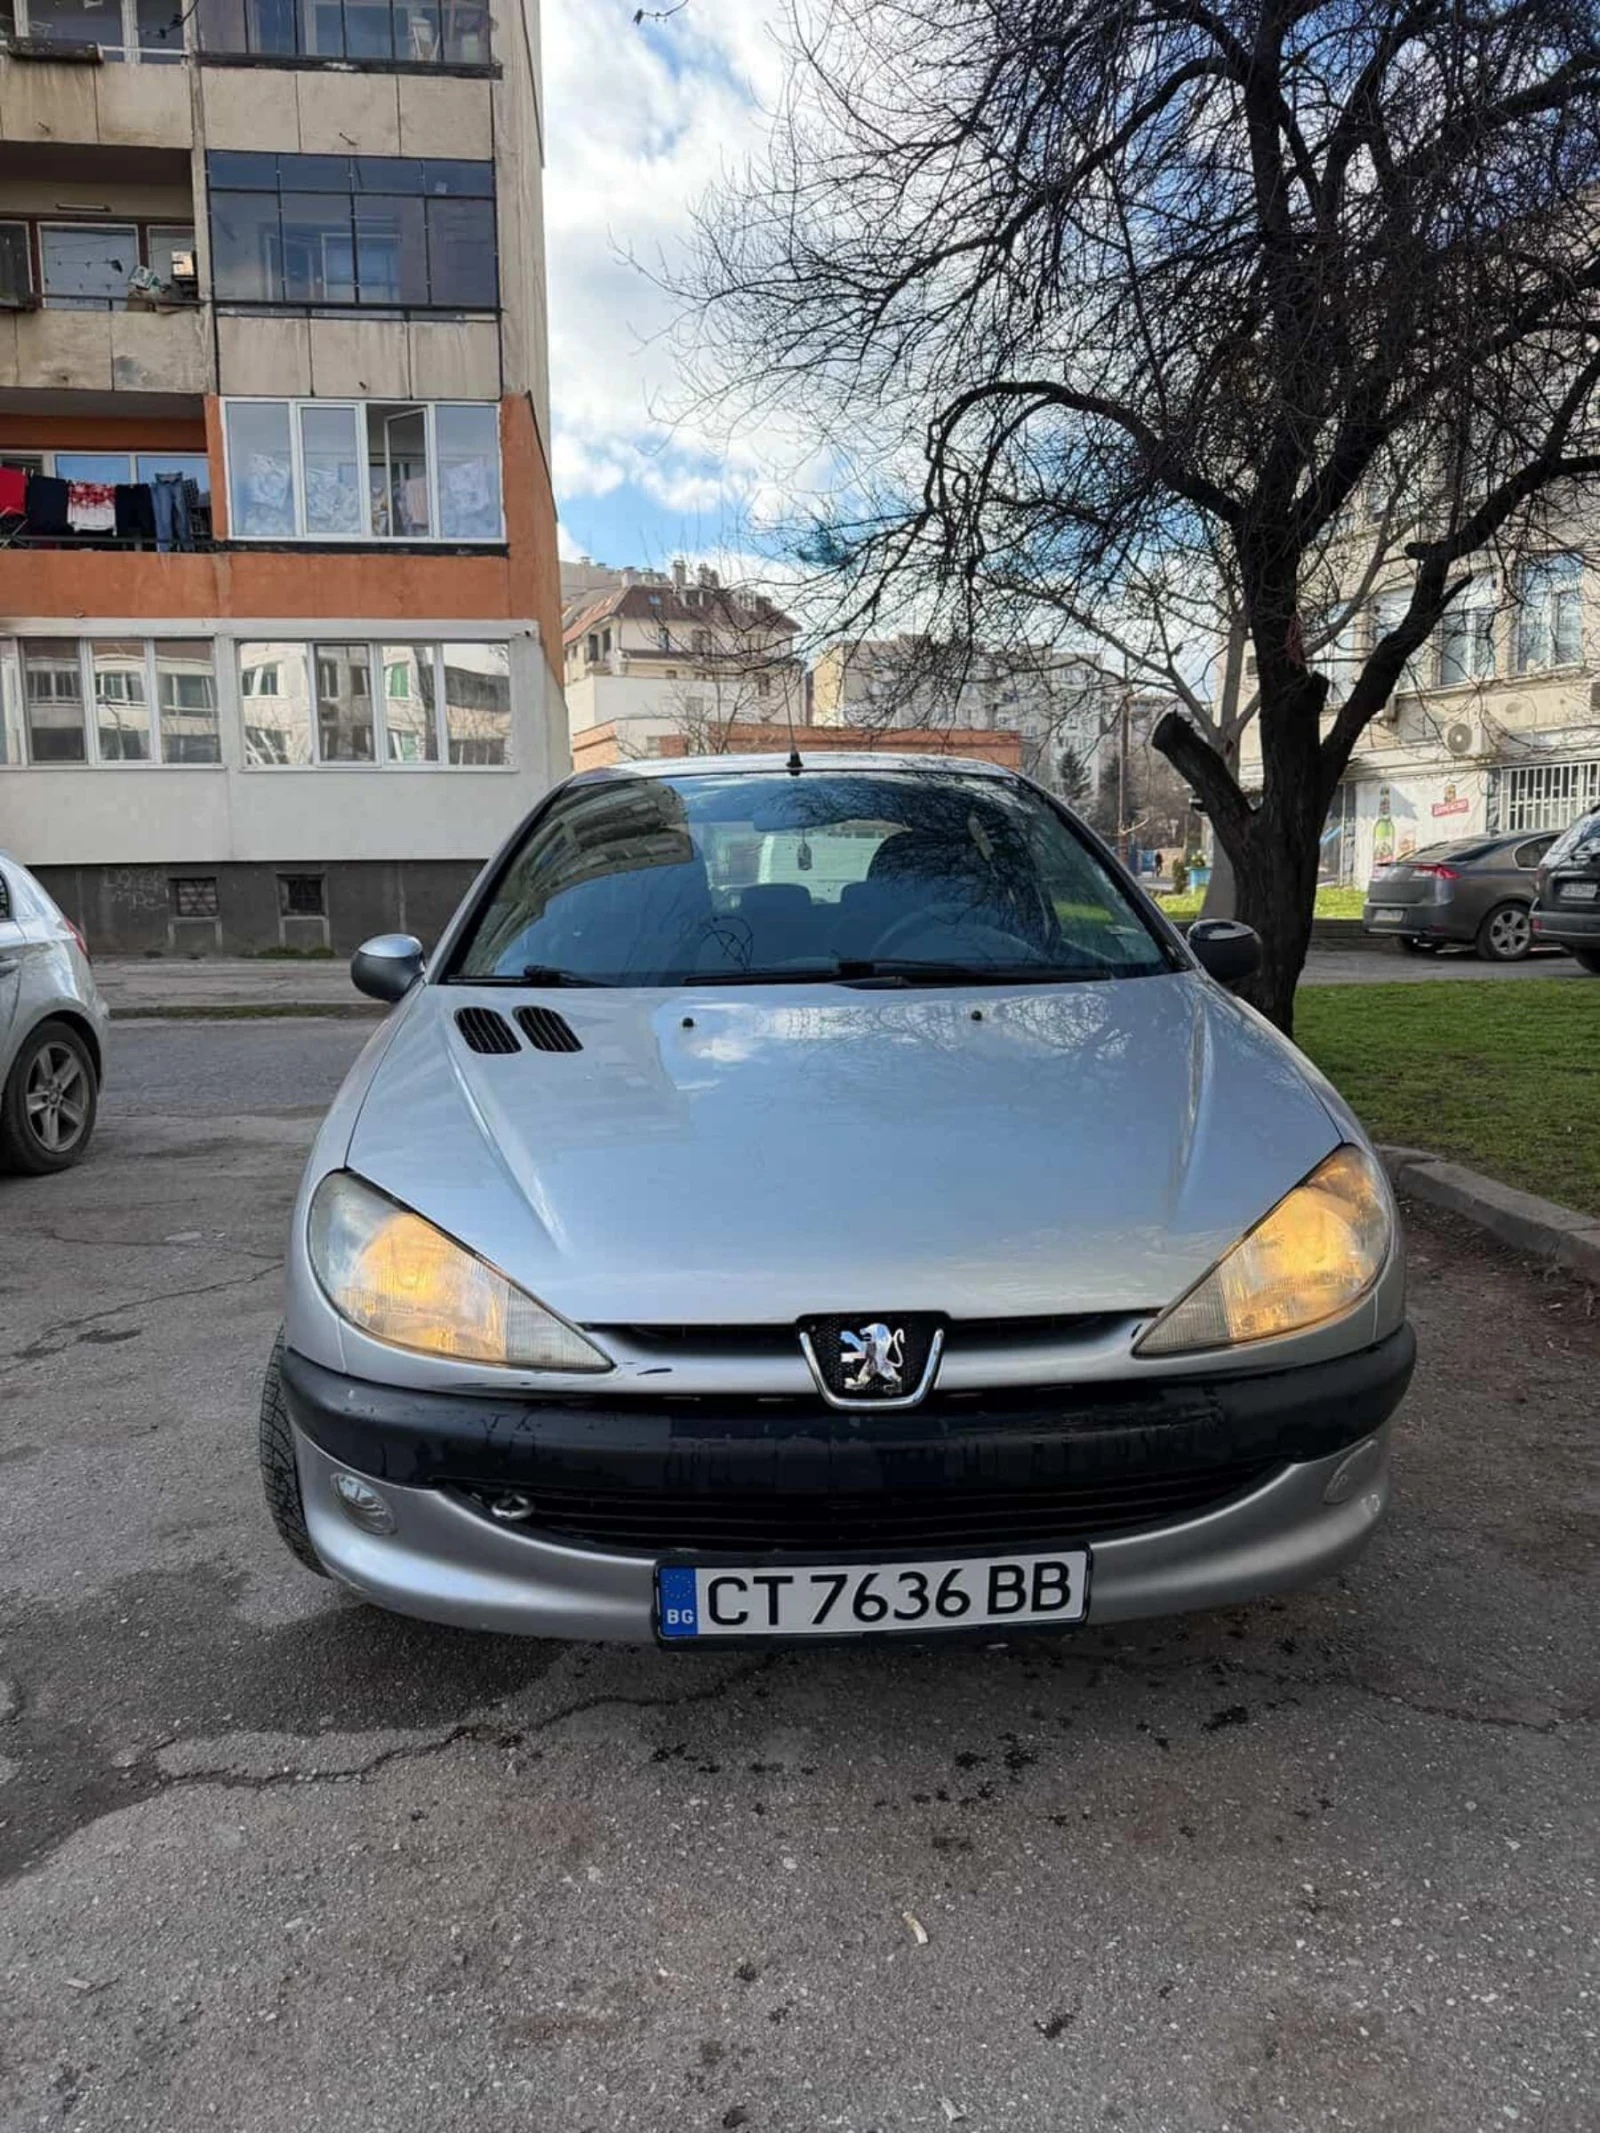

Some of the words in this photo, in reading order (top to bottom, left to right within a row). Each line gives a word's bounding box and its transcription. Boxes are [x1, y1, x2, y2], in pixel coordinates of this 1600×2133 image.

[707, 1575, 794, 1626] CT
[809, 1568, 971, 1625] 7636
[986, 1561, 1072, 1616] BB
[667, 1610, 695, 1625] BG
